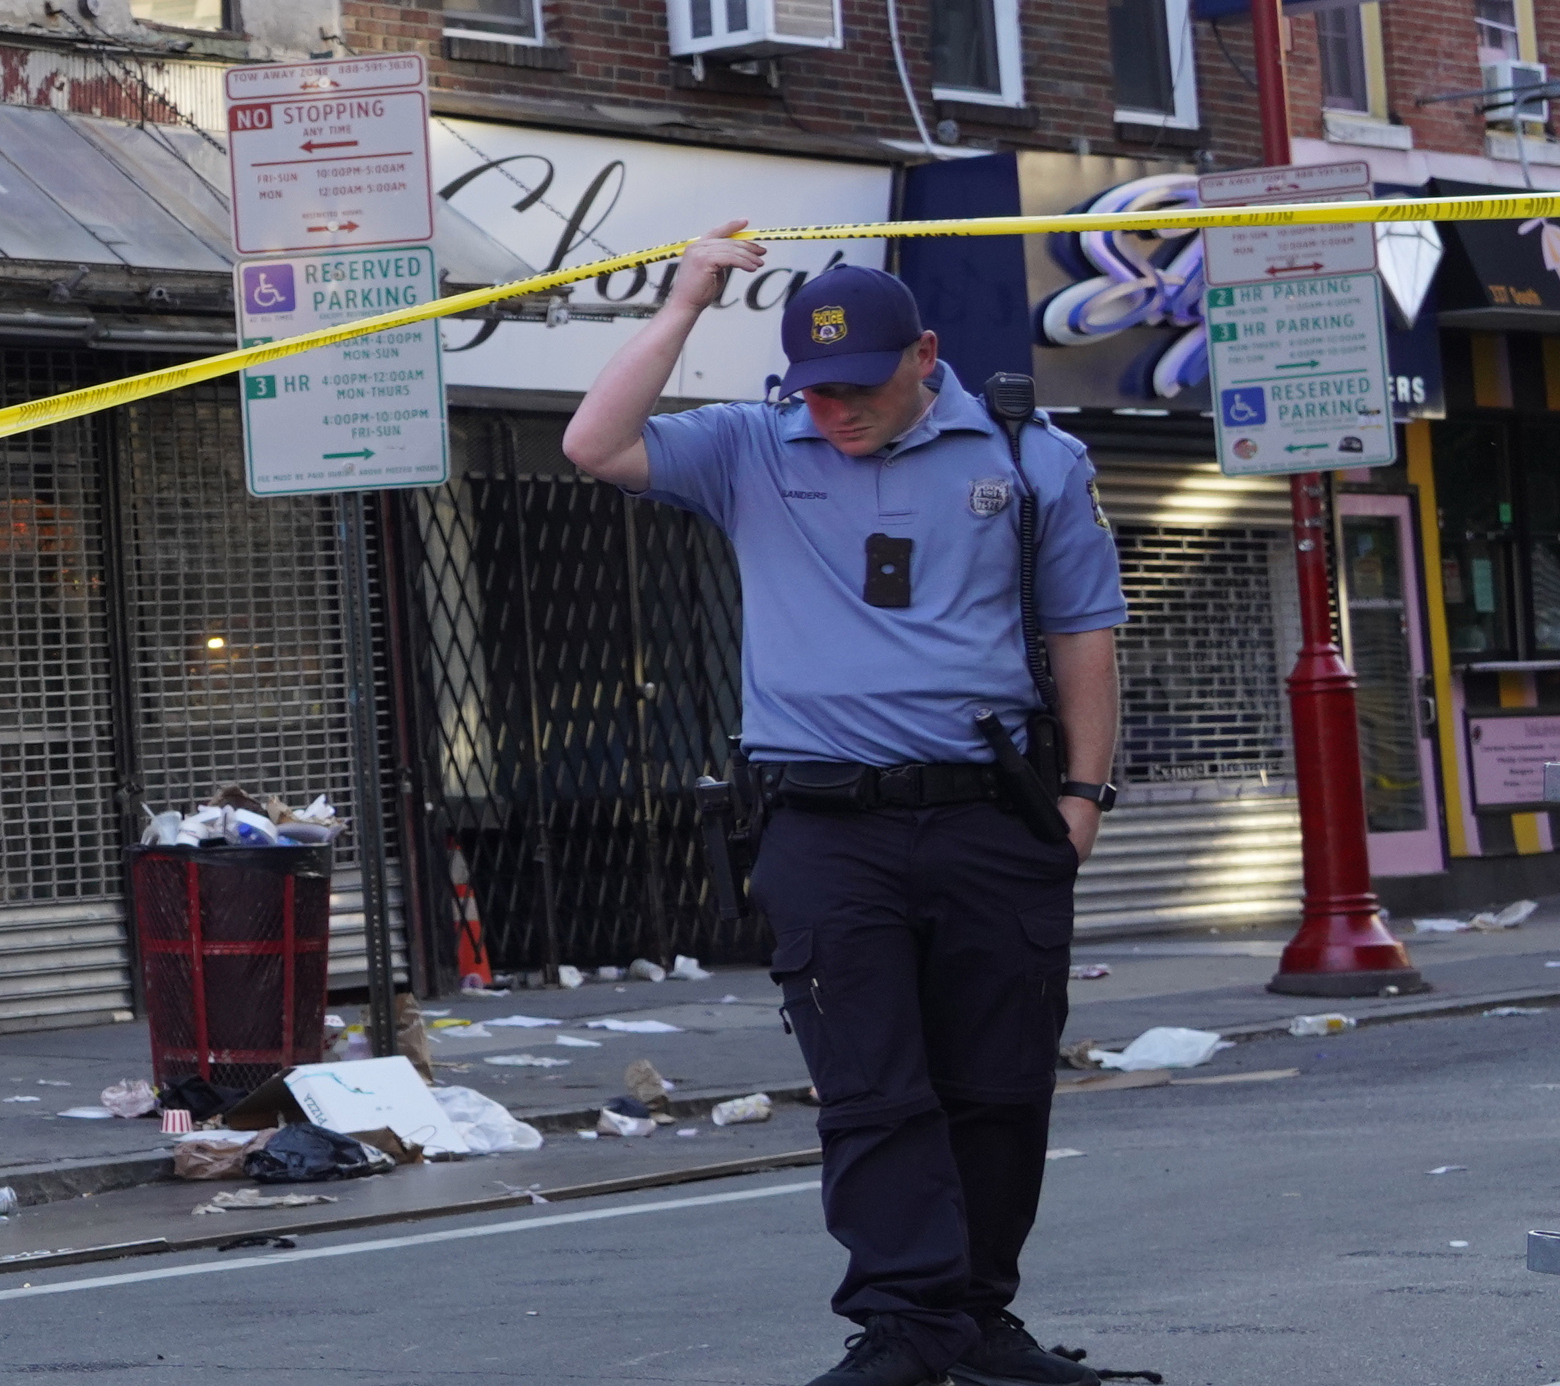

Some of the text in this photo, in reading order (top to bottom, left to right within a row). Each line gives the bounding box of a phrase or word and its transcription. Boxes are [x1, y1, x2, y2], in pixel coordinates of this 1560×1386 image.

[234, 72, 258, 82] TOW
[263, 70, 295, 80] AWAY
[300, 66, 329, 77] ZONE
[237, 100, 385, 129] NO STOPPING
[303, 124, 352, 137] ANY TIME
[257, 172, 298, 184] FRI-SUN
[259, 190, 283, 200] MON
[305, 256, 421, 284] RESERVED
[313, 285, 418, 312] PARKING
[1216, 278, 1352, 305] 2 HR PARKING
[813, 313, 844, 326] POLICE
[1219, 314, 1355, 340] 3 HR PARKING
[343, 349, 400, 361] MON-SUN
[256, 370, 425, 396] 3 HR 4:00PM-12:00AM
[1271, 377, 1371, 401] RESERVED
[337, 384, 410, 400] MON-THURS
[322, 409, 429, 425] 4:00PM-10:00PM
[1279, 398, 1367, 421] PARKING
[352, 426, 401, 439] FRI-SUN
[782, 489, 827, 500] SANDERS
